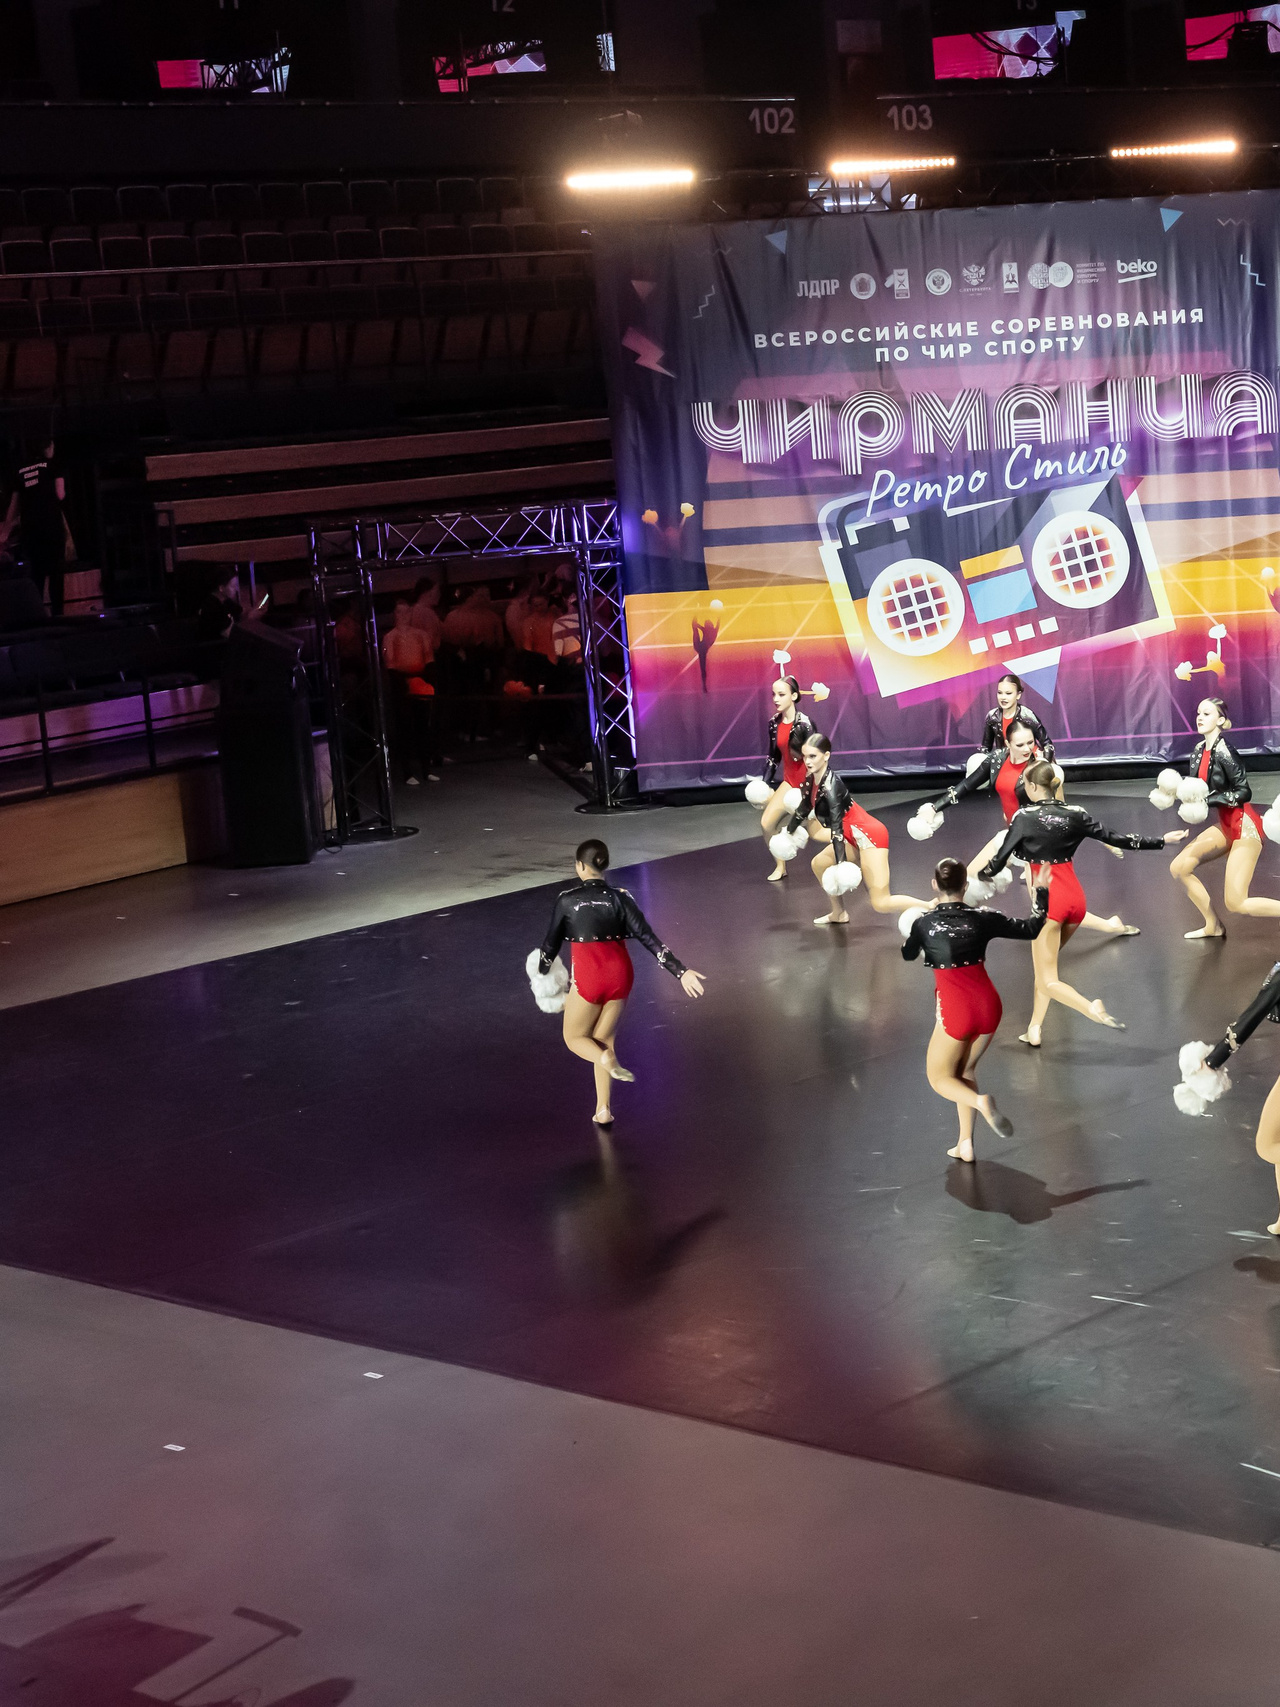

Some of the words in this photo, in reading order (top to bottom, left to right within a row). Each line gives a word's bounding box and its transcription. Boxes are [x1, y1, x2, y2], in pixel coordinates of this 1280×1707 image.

[749, 107, 795, 134] 102
[887, 104, 932, 131] 103
[1117, 259, 1158, 274] beko
[797, 279, 840, 298] ЛДПР
[754, 321, 979, 348] ВСЕРОССИЙСКИЕ
[991, 308, 1204, 335] СОРЕВНОВАНИЯ
[875, 346, 909, 362] ПО
[921, 343, 972, 360] ЧИР
[984, 335, 1085, 357] СПОРТУ
[866, 468, 988, 517] Ретро
[1005, 443, 1127, 490] Стиль
